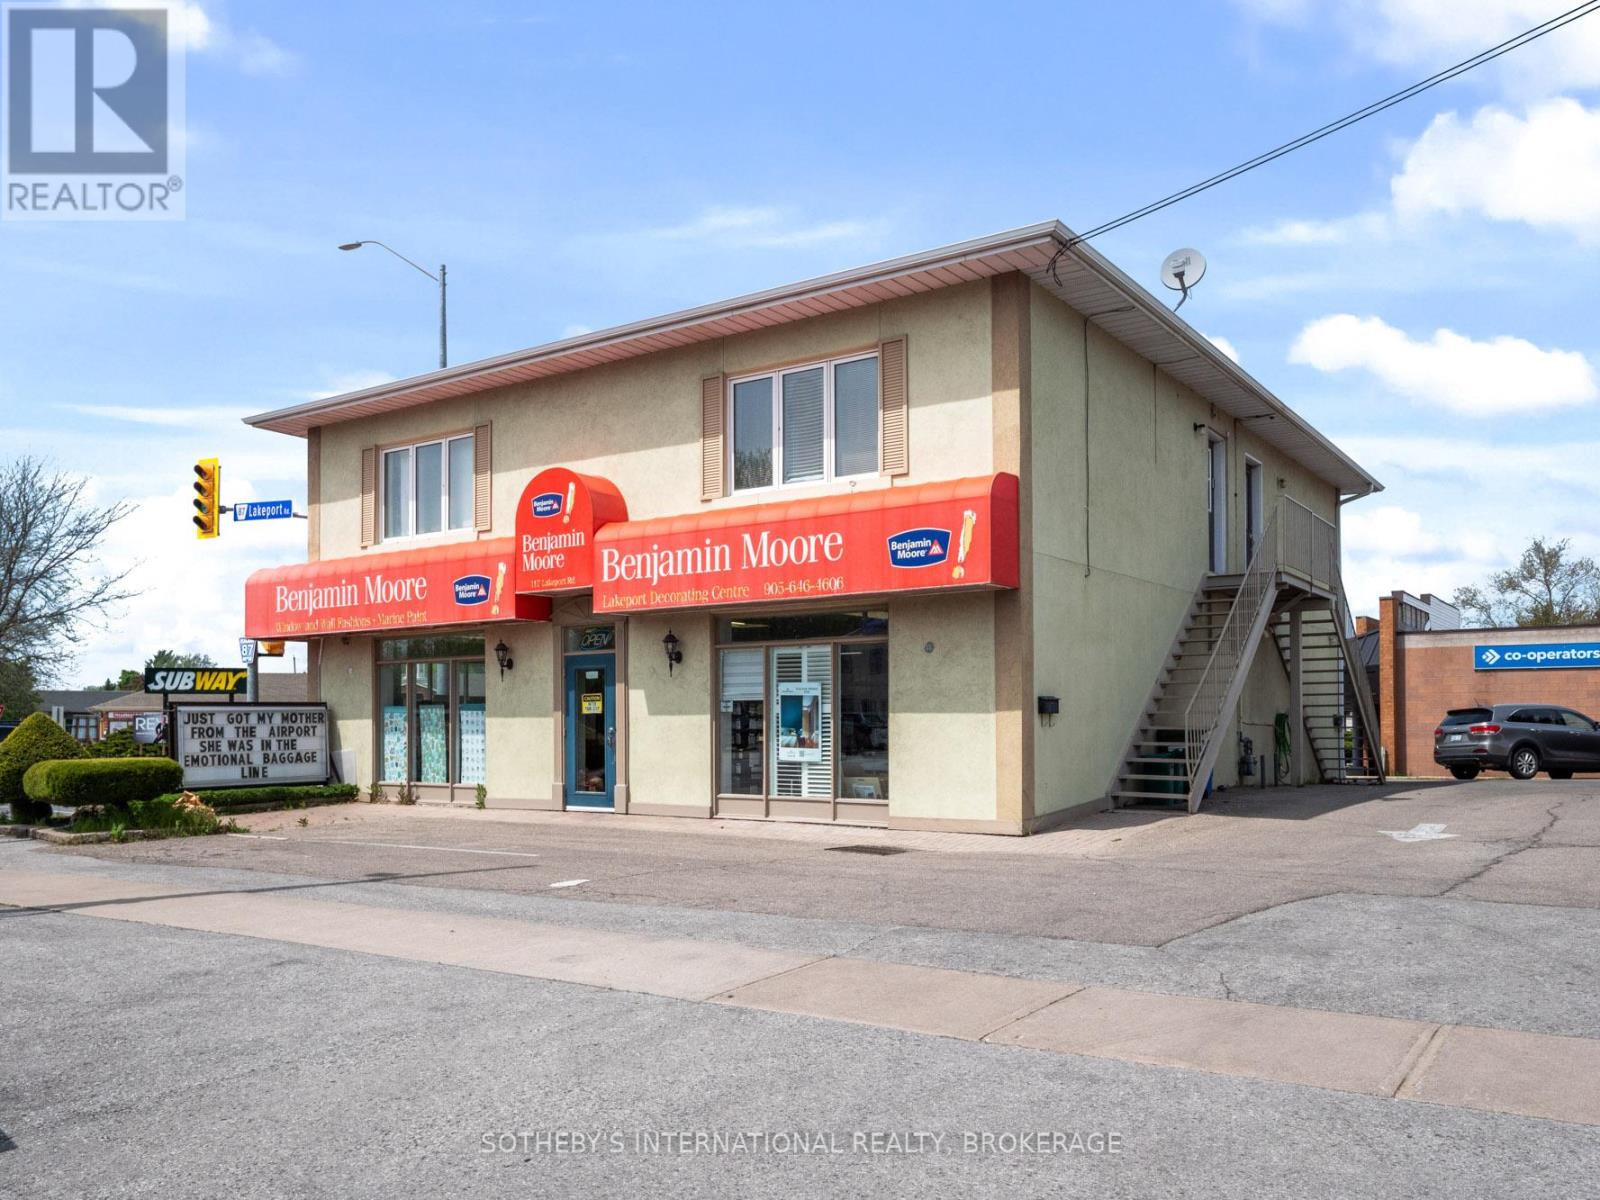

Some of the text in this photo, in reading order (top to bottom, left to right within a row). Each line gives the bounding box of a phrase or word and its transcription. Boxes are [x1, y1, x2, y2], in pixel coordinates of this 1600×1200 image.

[248, 504, 283, 519] Lakeport
[522, 528, 585, 554] Benjamin
[890, 537, 932, 551] Benjamin
[601, 530, 844, 586] Benjamin Moore
[897, 549, 926, 560] Moore
[522, 552, 565, 572] Moore
[455, 582, 480, 592] Benjamin
[602, 576, 844, 609] Lakeport Decorating Centre 905-646-4606
[275, 575, 427, 617] Benjamin Moore
[458, 591, 477, 599] Moore
[581, 633, 611, 646] OPEN
[241, 644, 254, 656] 87
[1504, 649, 1600, 663] co-operators
[147, 671, 248, 691] SUBWAY
[183, 712, 325, 725] JUST GOT MY MOTHER
[191, 725, 318, 739] FROM THE AIRPORT
[200, 739, 297, 752] SHE WAS IN THE
[184, 752, 317, 767] EMOTIONAL BAGGAGE
[241, 766, 268, 779] LINE
